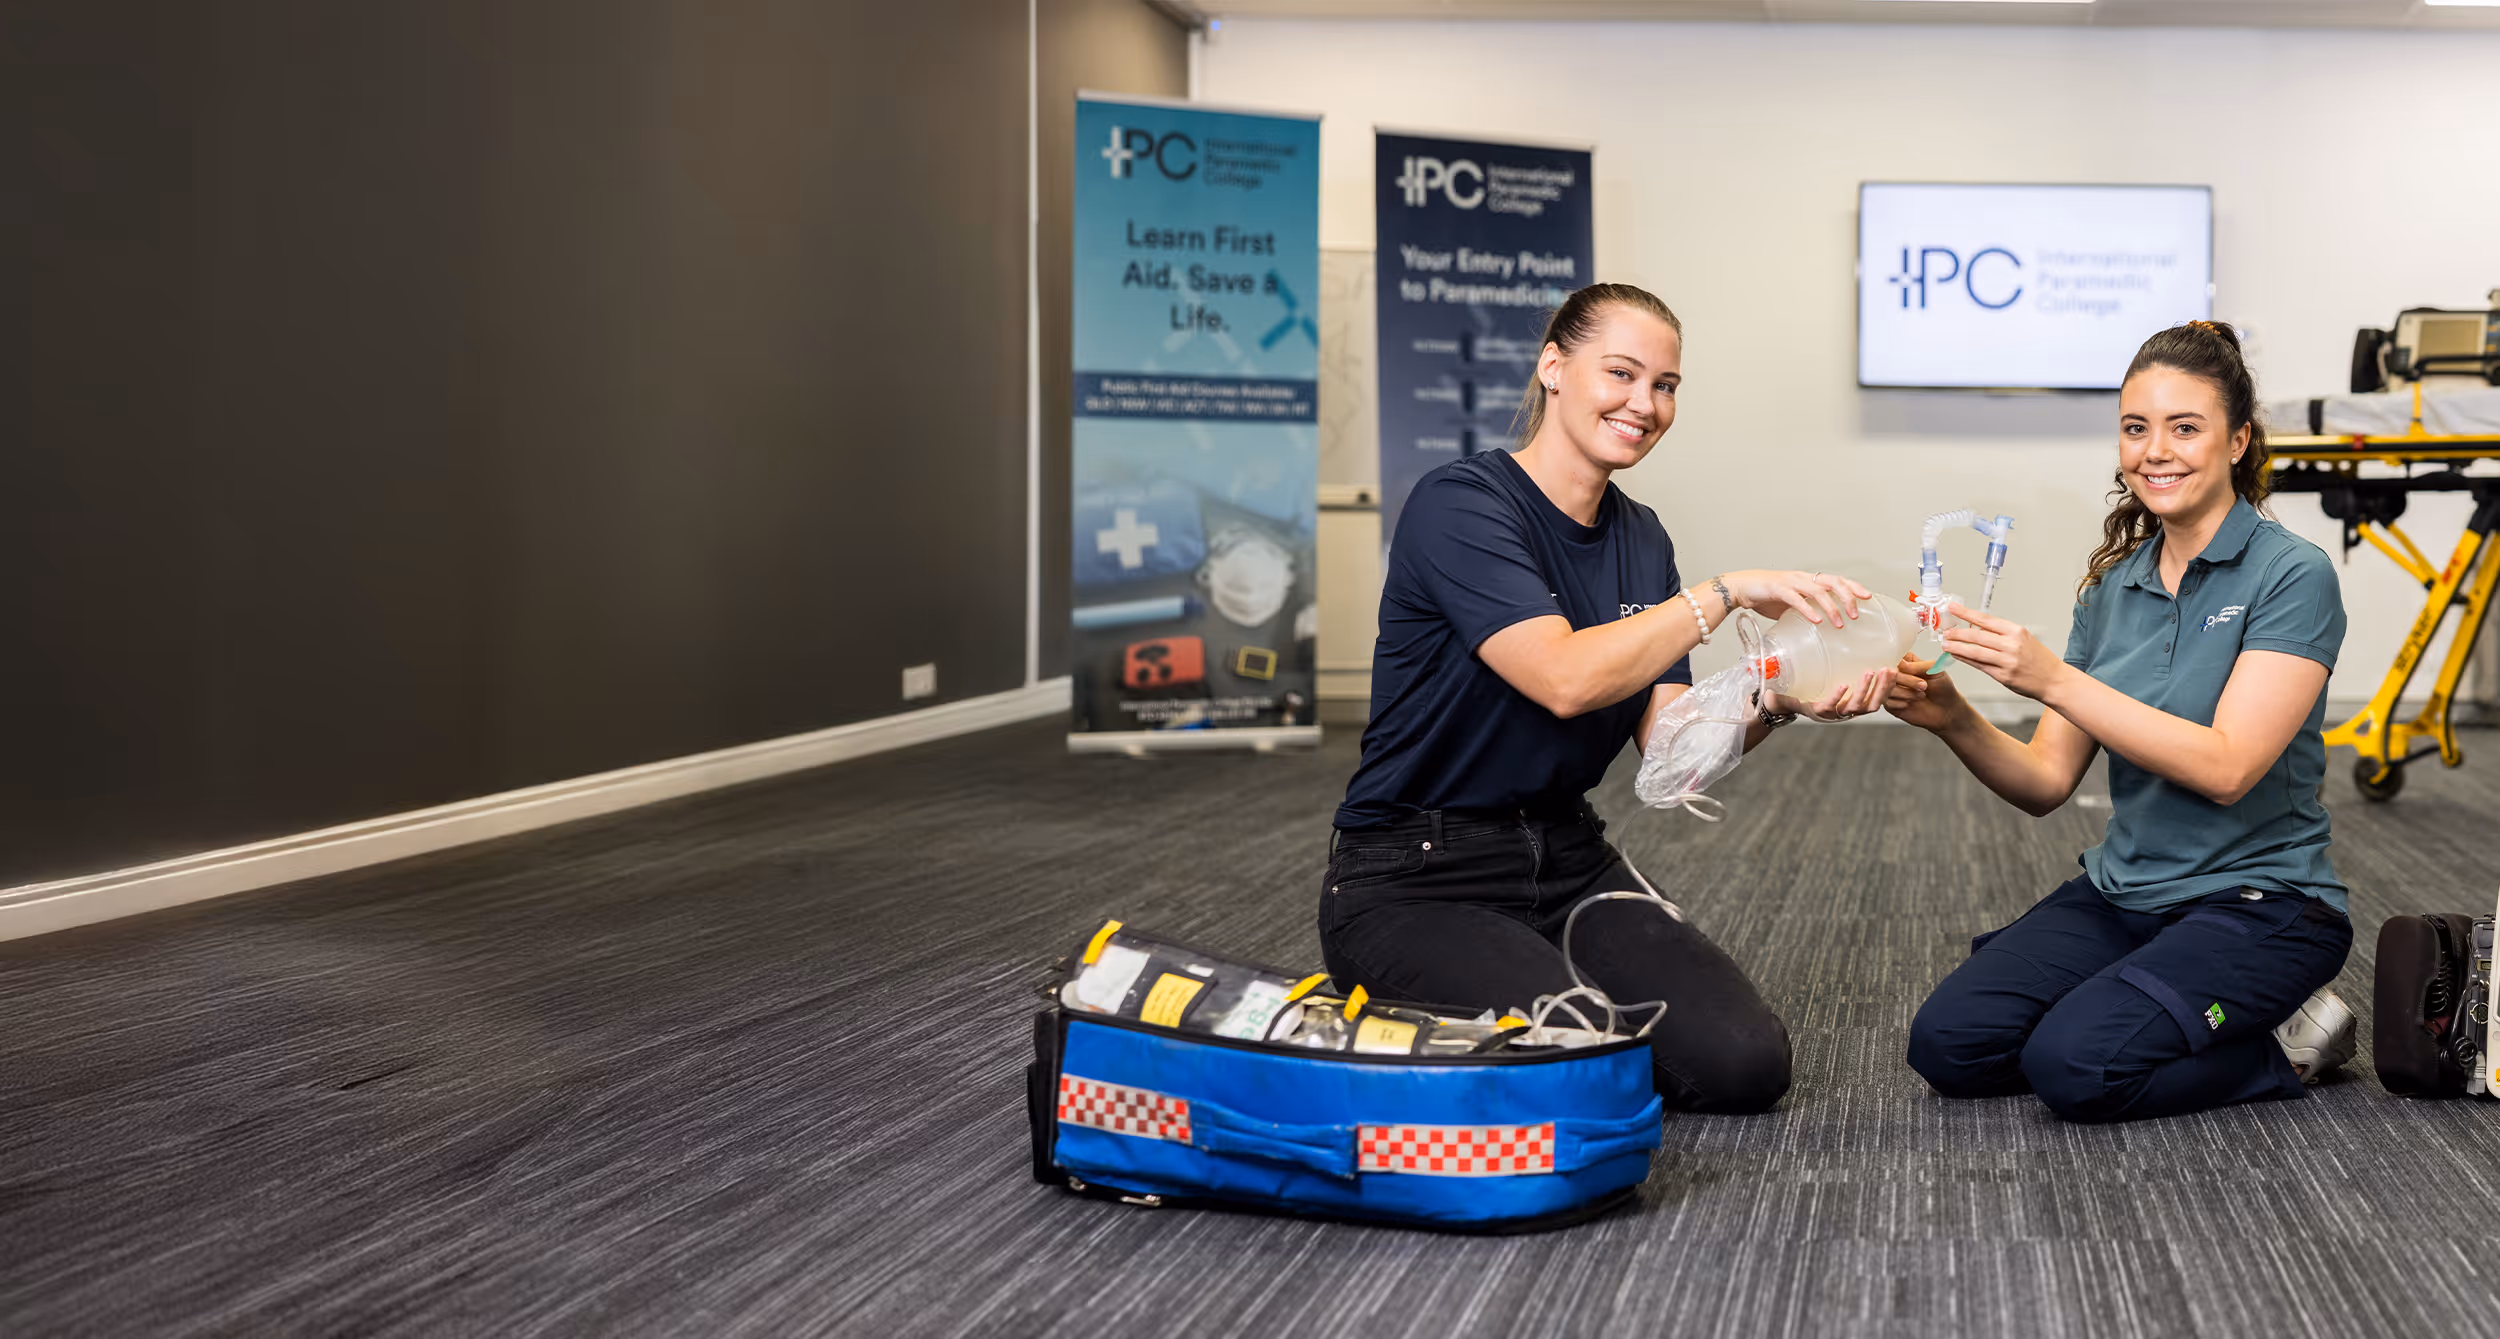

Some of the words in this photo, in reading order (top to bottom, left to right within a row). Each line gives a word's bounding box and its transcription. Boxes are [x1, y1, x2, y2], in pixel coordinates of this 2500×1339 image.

[1126, 219, 1206, 250] Learn
[1213, 225, 1275, 254] First
[1122, 262, 1179, 289] Aid.
[1187, 265, 1255, 293] Save
[1262, 275, 1280, 293] a
[1401, 246, 1451, 273] Your
[1457, 250, 1515, 280] Entry
[1519, 253, 1575, 279] Point
[1400, 279, 1425, 301] to
[1170, 304, 1229, 332] Life.
